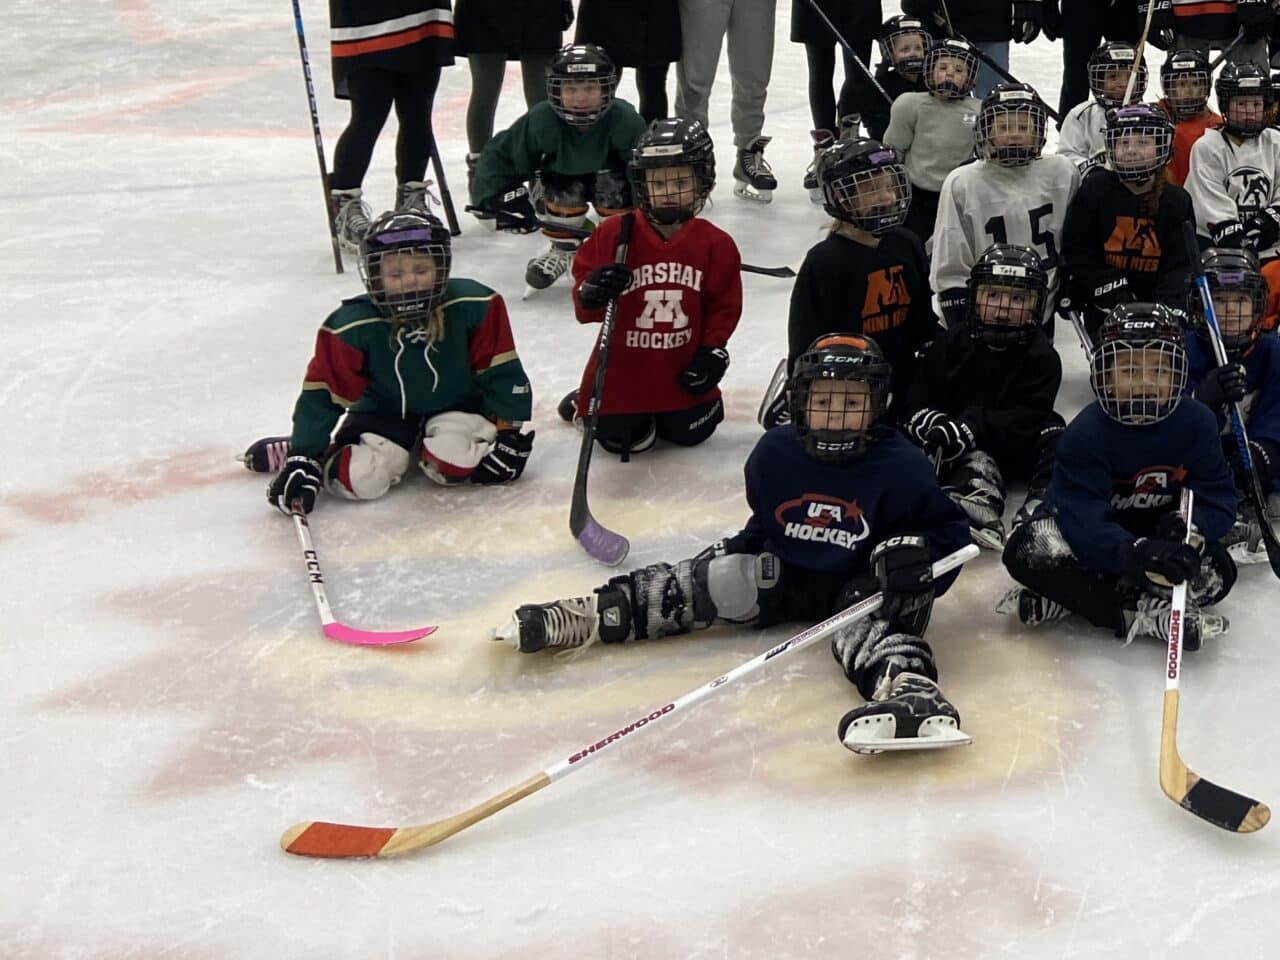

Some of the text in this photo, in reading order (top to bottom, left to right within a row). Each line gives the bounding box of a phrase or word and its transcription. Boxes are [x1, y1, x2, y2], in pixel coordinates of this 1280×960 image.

[984, 203, 1057, 271] 15
[620, 261, 704, 296] ARSHAL
[625, 327, 693, 350] HOCKEY
[1124, 321, 1156, 329] CCM
[784, 521, 859, 551] HOCKEY
[303, 549, 324, 584] CCM
[1167, 609, 1181, 680] SHERWOOD
[567, 703, 676, 765] SHERWOOD
